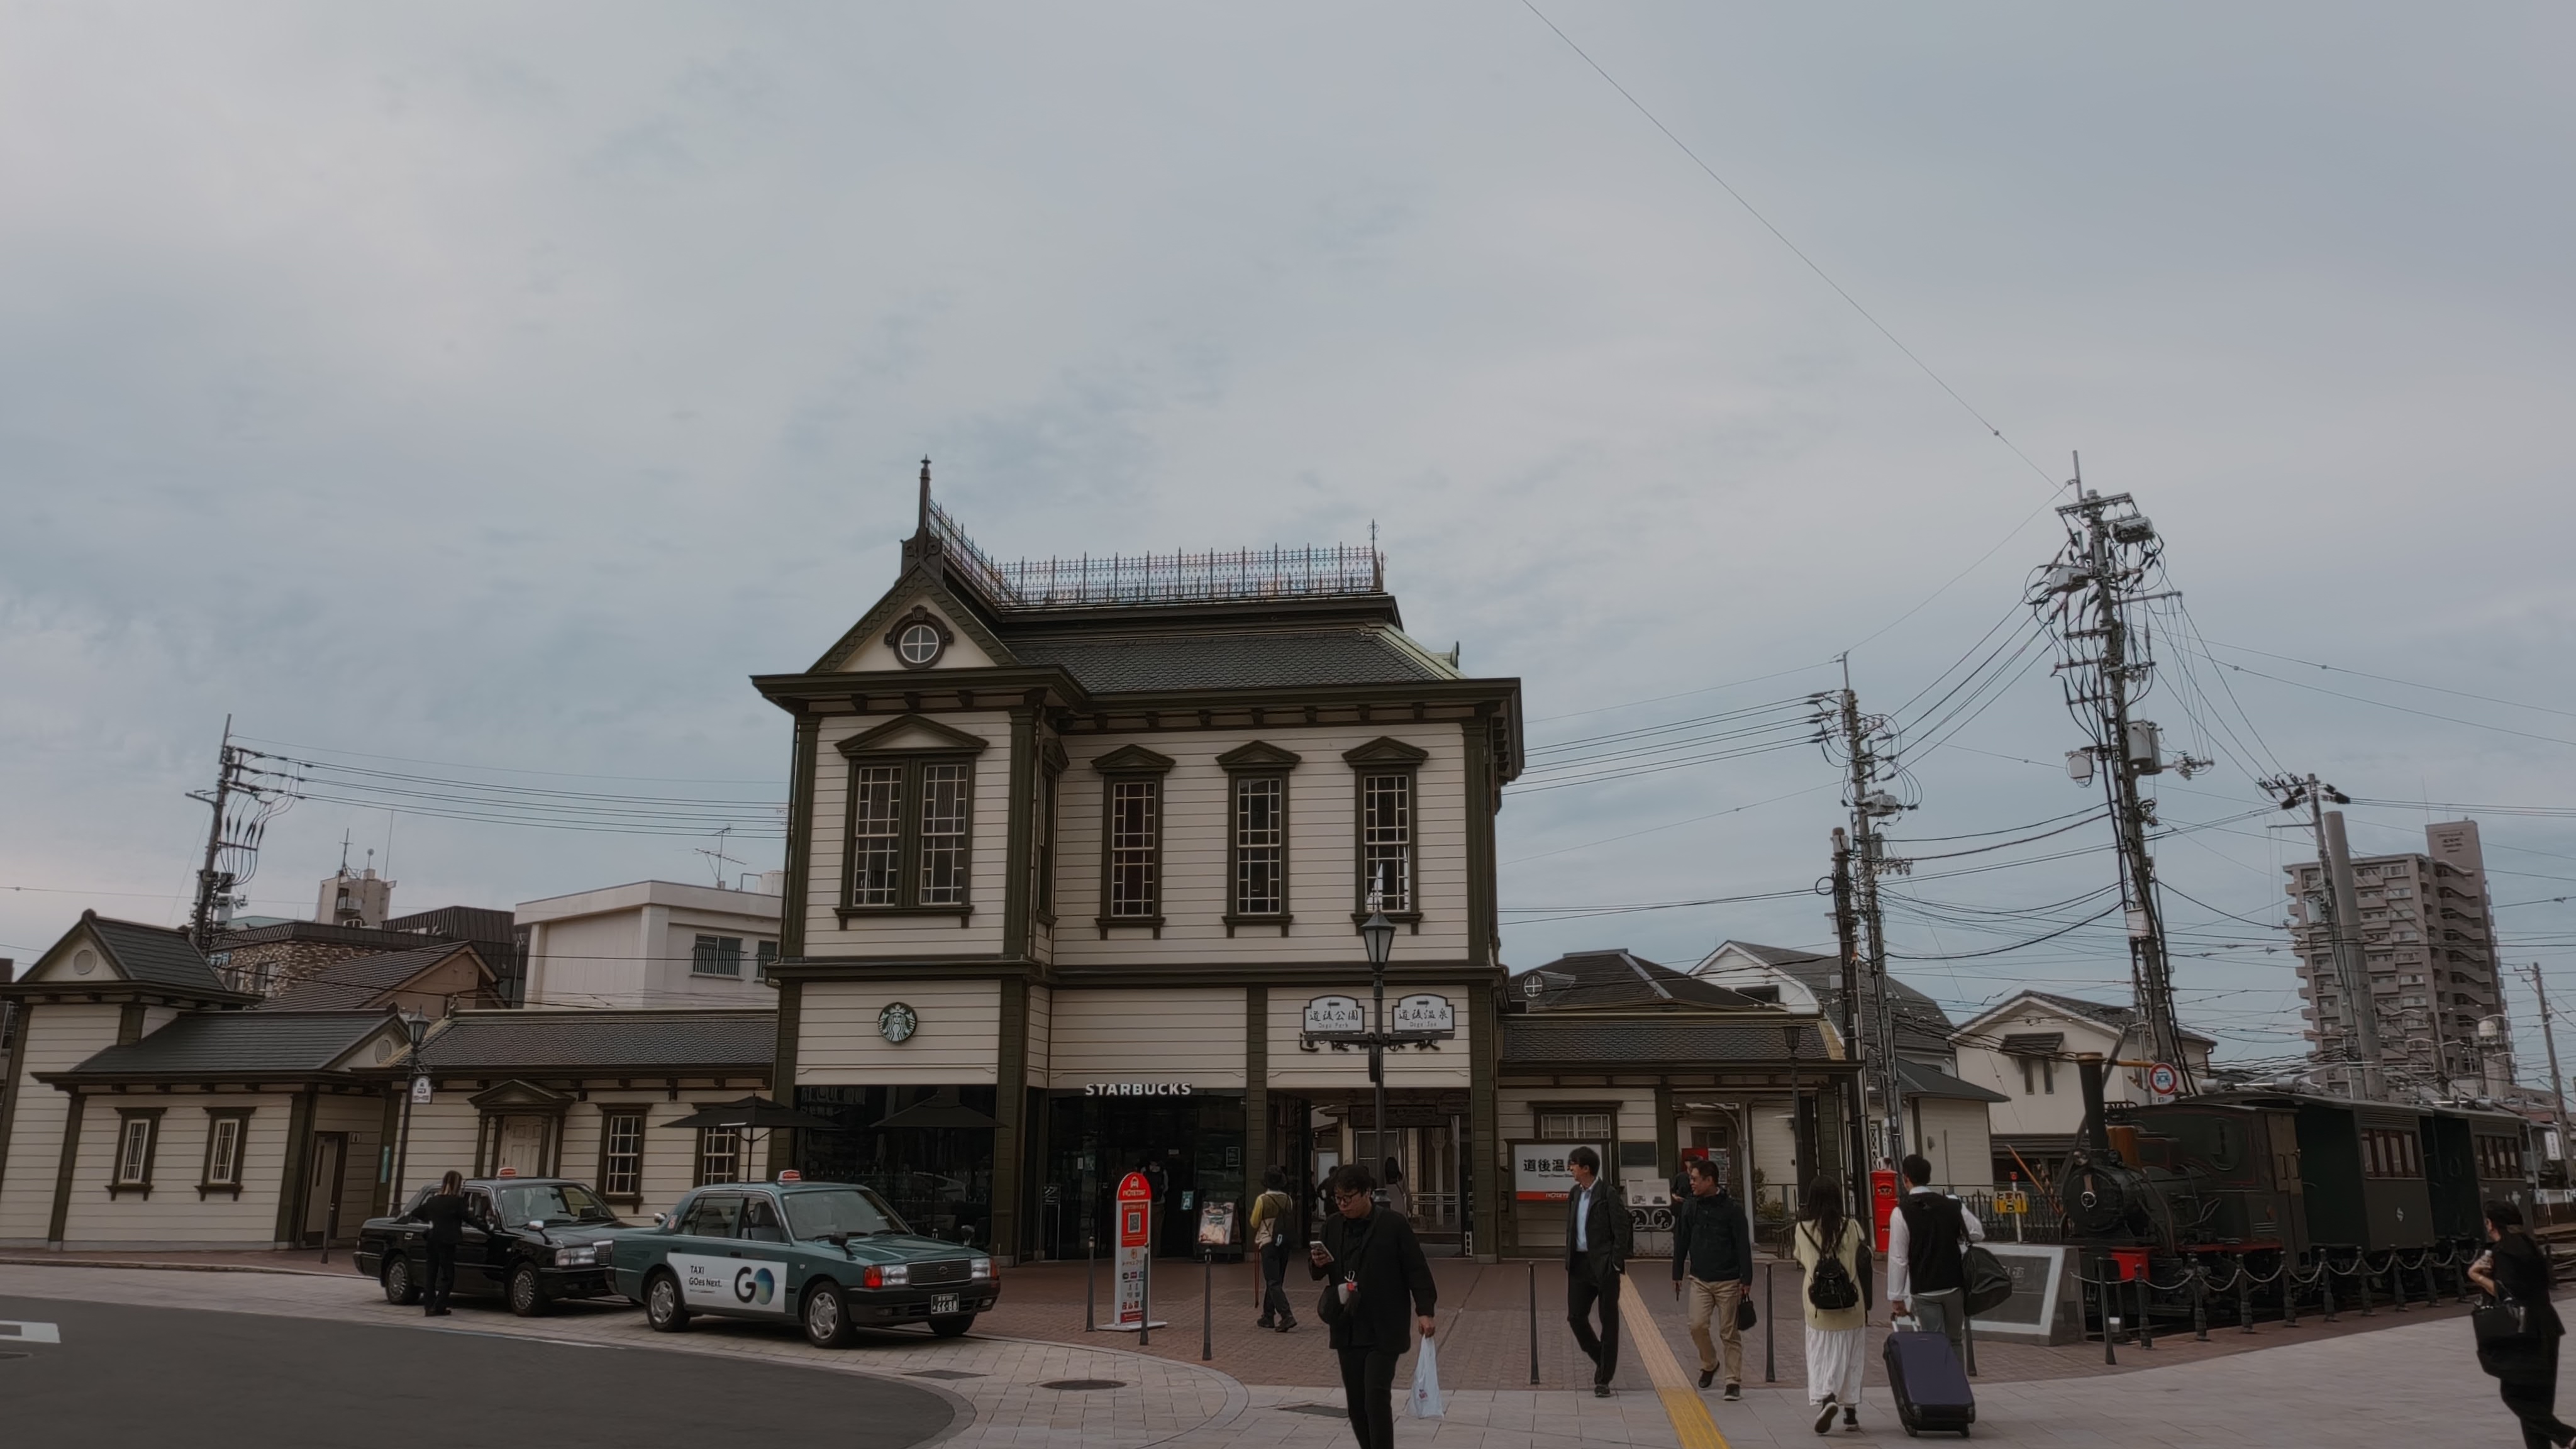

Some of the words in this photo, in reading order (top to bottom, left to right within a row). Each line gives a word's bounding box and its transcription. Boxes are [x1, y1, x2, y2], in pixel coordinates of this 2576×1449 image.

[1309, 1009, 1358, 1021] 道後公園
[1398, 1008, 1449, 1020] 道後温泉
[1085, 1082, 1192, 1096] STARBUCKS
[1523, 1158, 1570, 1172] 道後温
[690, 1265, 705, 1275] TAXI
[689, 1277, 705, 1286] GOes
[706, 1278, 723, 1287] Next.
[735, 1266, 775, 1305] GO
